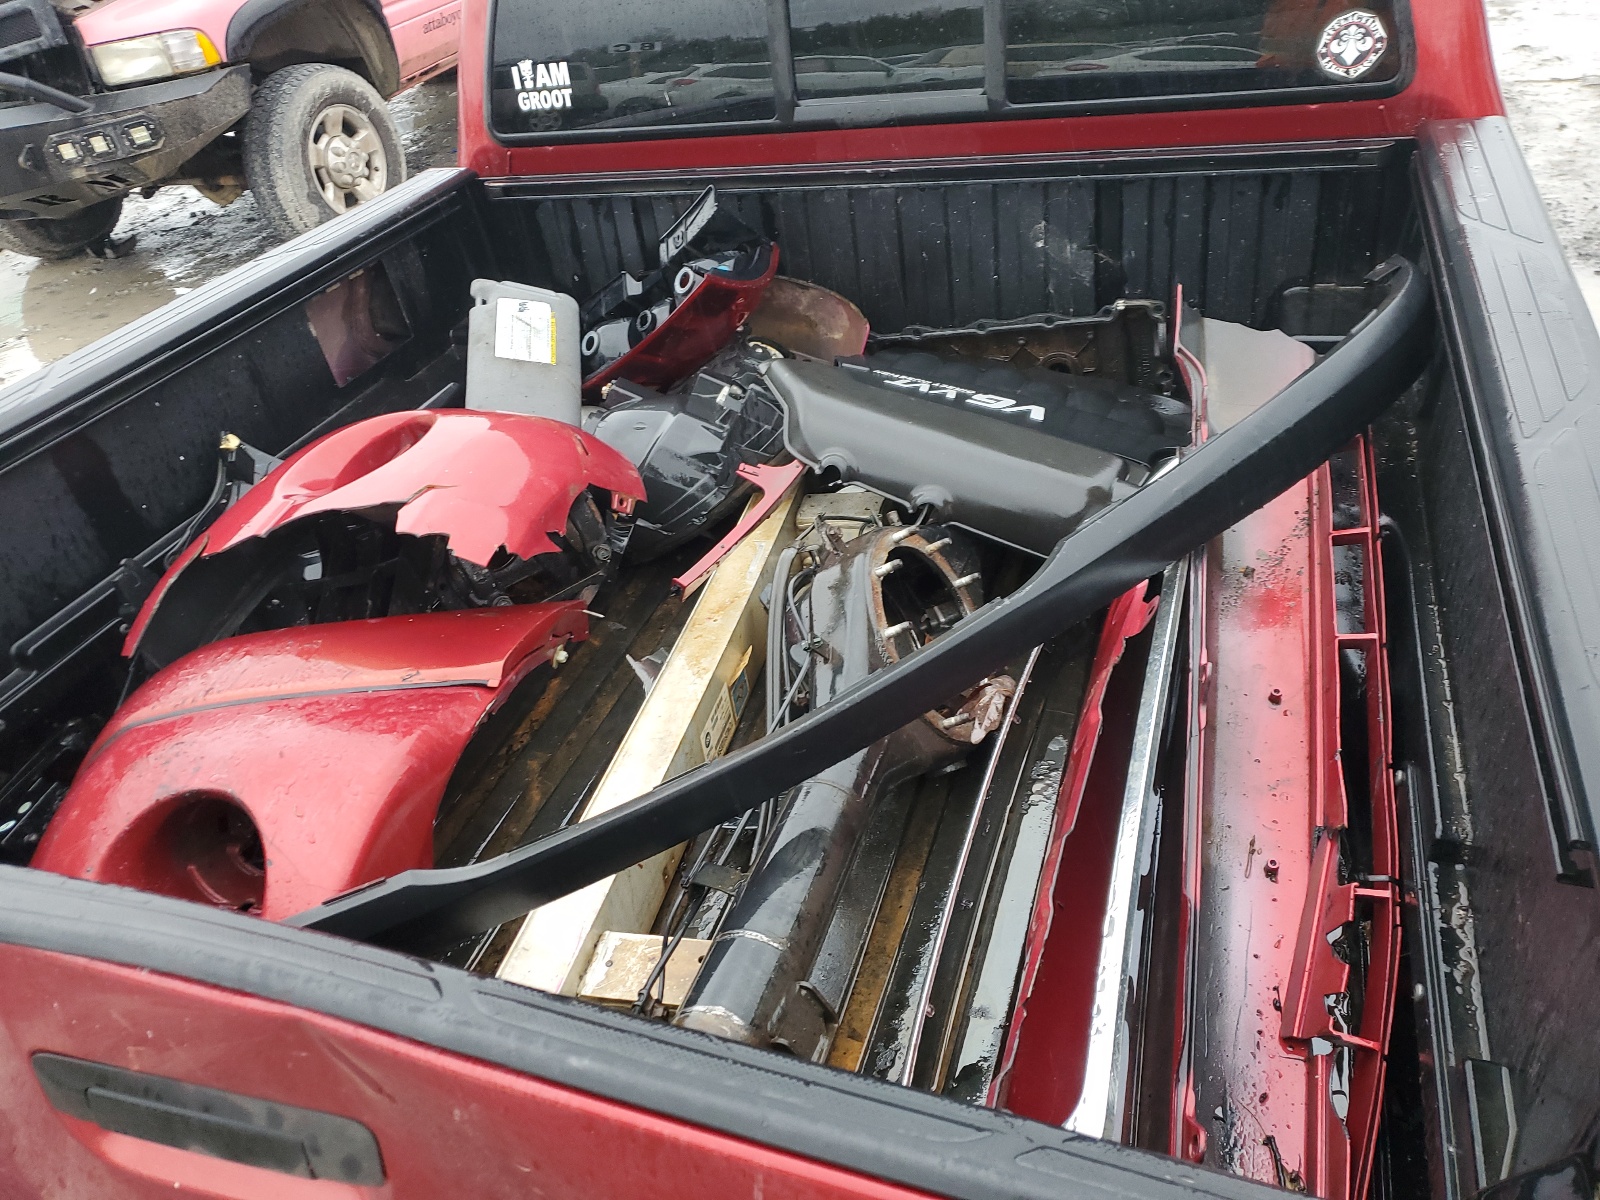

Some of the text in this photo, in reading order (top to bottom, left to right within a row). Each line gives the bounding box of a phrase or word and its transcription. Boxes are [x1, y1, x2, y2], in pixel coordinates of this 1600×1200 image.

[511, 61, 571, 90] I AM
[518, 88, 573, 111] GROOT
[965, 393, 1046, 422] V6
